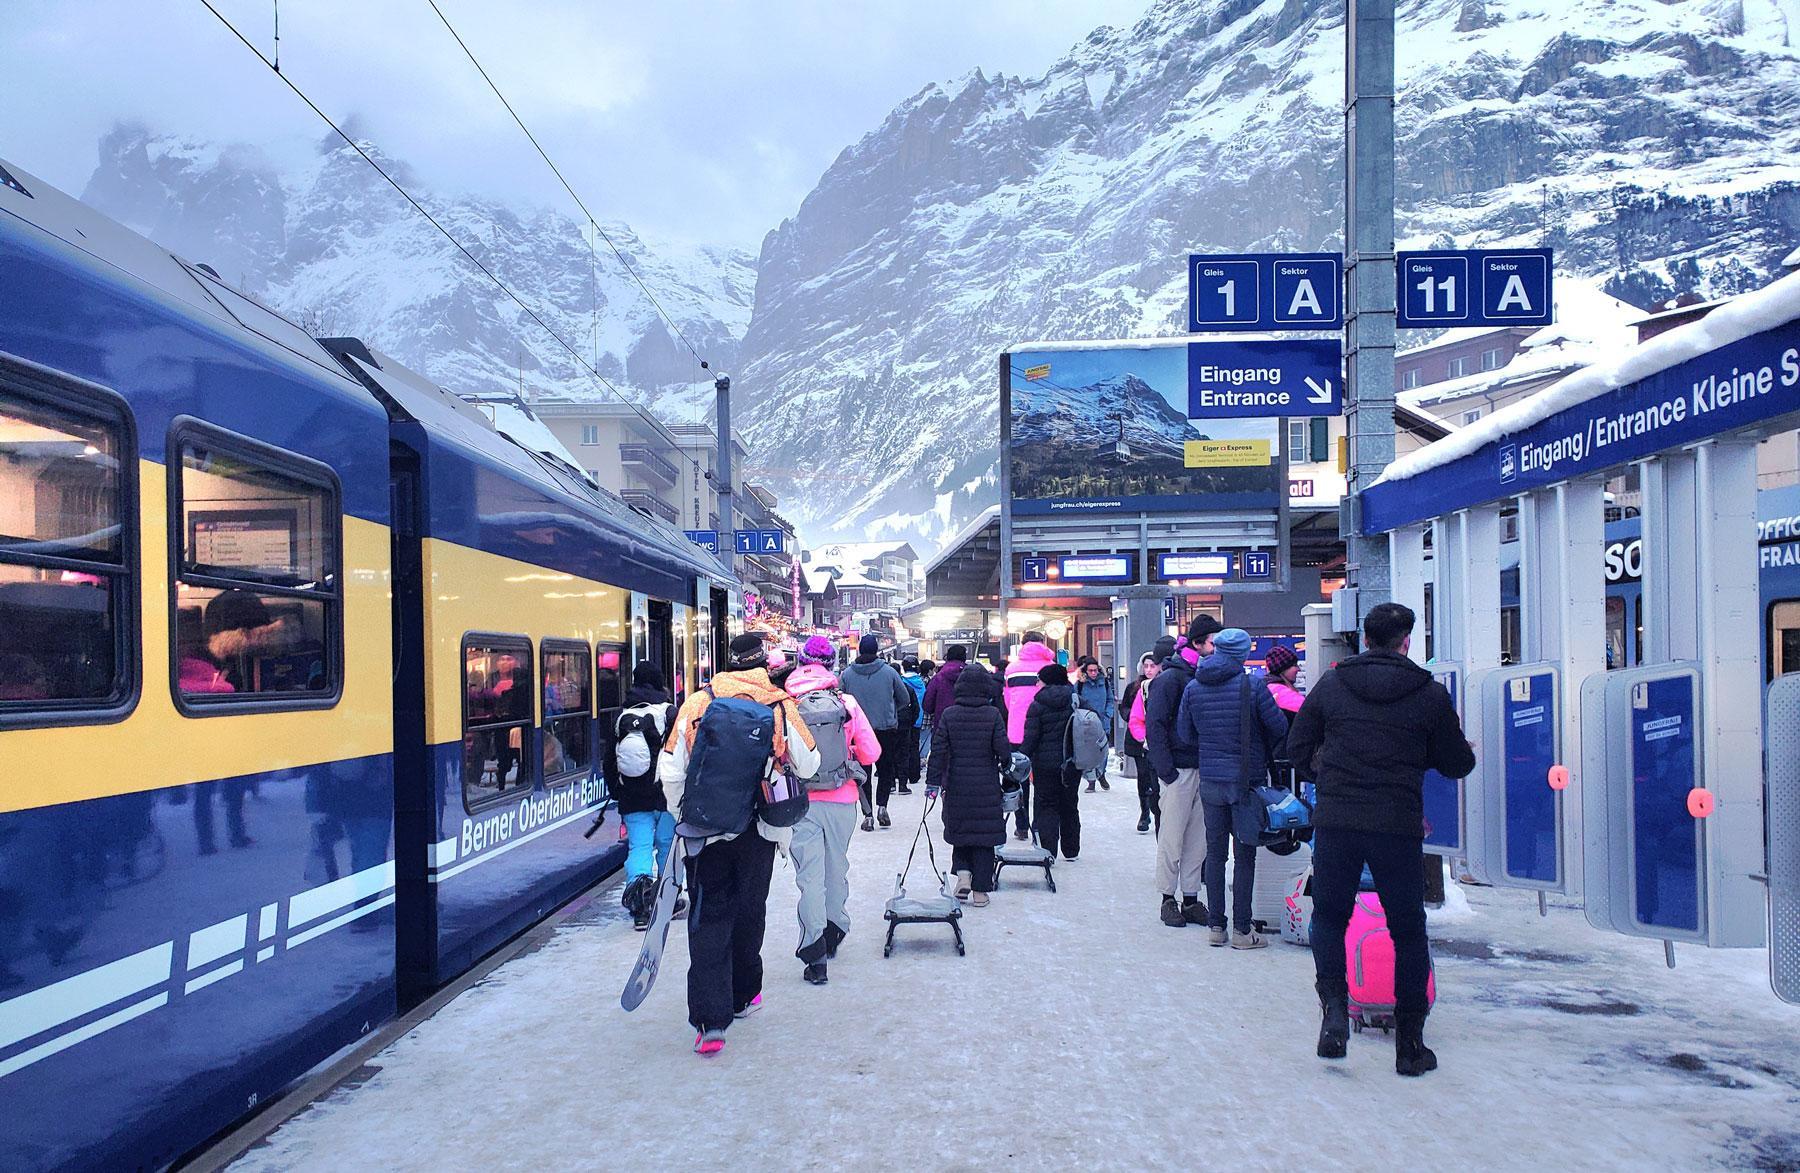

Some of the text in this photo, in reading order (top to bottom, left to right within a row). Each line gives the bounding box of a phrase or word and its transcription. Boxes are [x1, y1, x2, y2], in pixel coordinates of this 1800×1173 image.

[1203, 268, 1224, 277] Gleis
[1281, 267, 1308, 275] Sektor
[1412, 265, 1433, 273] Gleis
[1490, 263, 1518, 272] Sektor
[1217, 280, 1235, 316] 1
[1287, 279, 1322, 315] A
[1416, 276, 1456, 312] 11
[1497, 275, 1532, 311] A
[1200, 365, 1281, 386] Eingang
[1693, 366, 1773, 416] Kleine
[1200, 390, 1290, 407] Entrance
[699, 542, 714, 550] WC
[743, 538, 750, 549] 1
[766, 538, 777, 549] A
[1032, 565, 1039, 578] 1
[1250, 560, 1265, 572] 11
[461, 810, 516, 857] Berner
